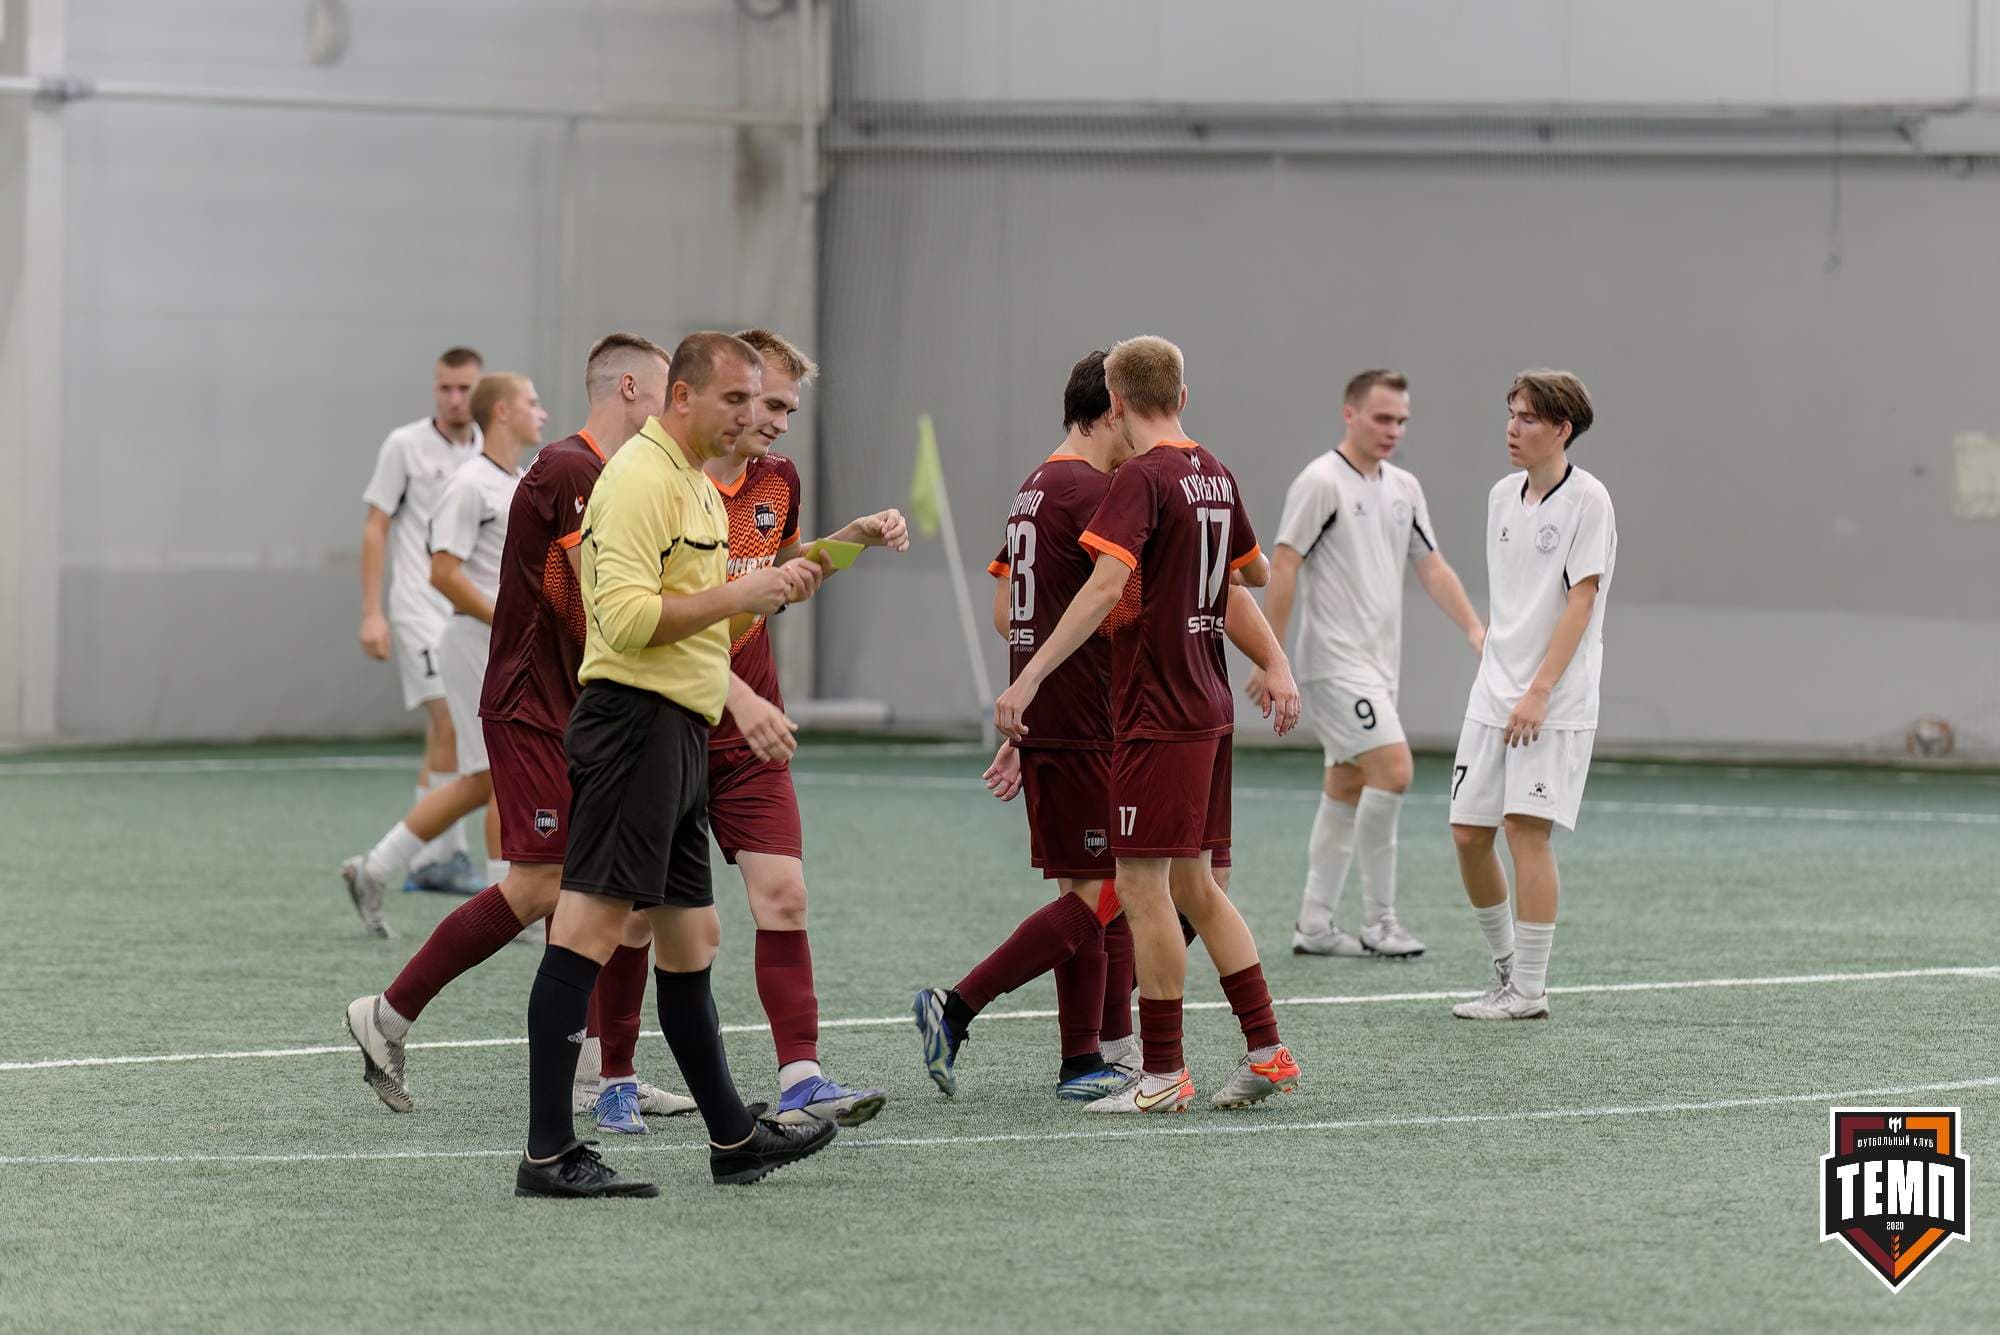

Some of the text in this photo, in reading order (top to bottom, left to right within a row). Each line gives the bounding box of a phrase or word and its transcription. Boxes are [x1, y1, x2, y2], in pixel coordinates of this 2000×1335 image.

[1196, 507, 1231, 609] 17
[1354, 698, 1377, 730] 9
[1118, 806, 1137, 836] 17
